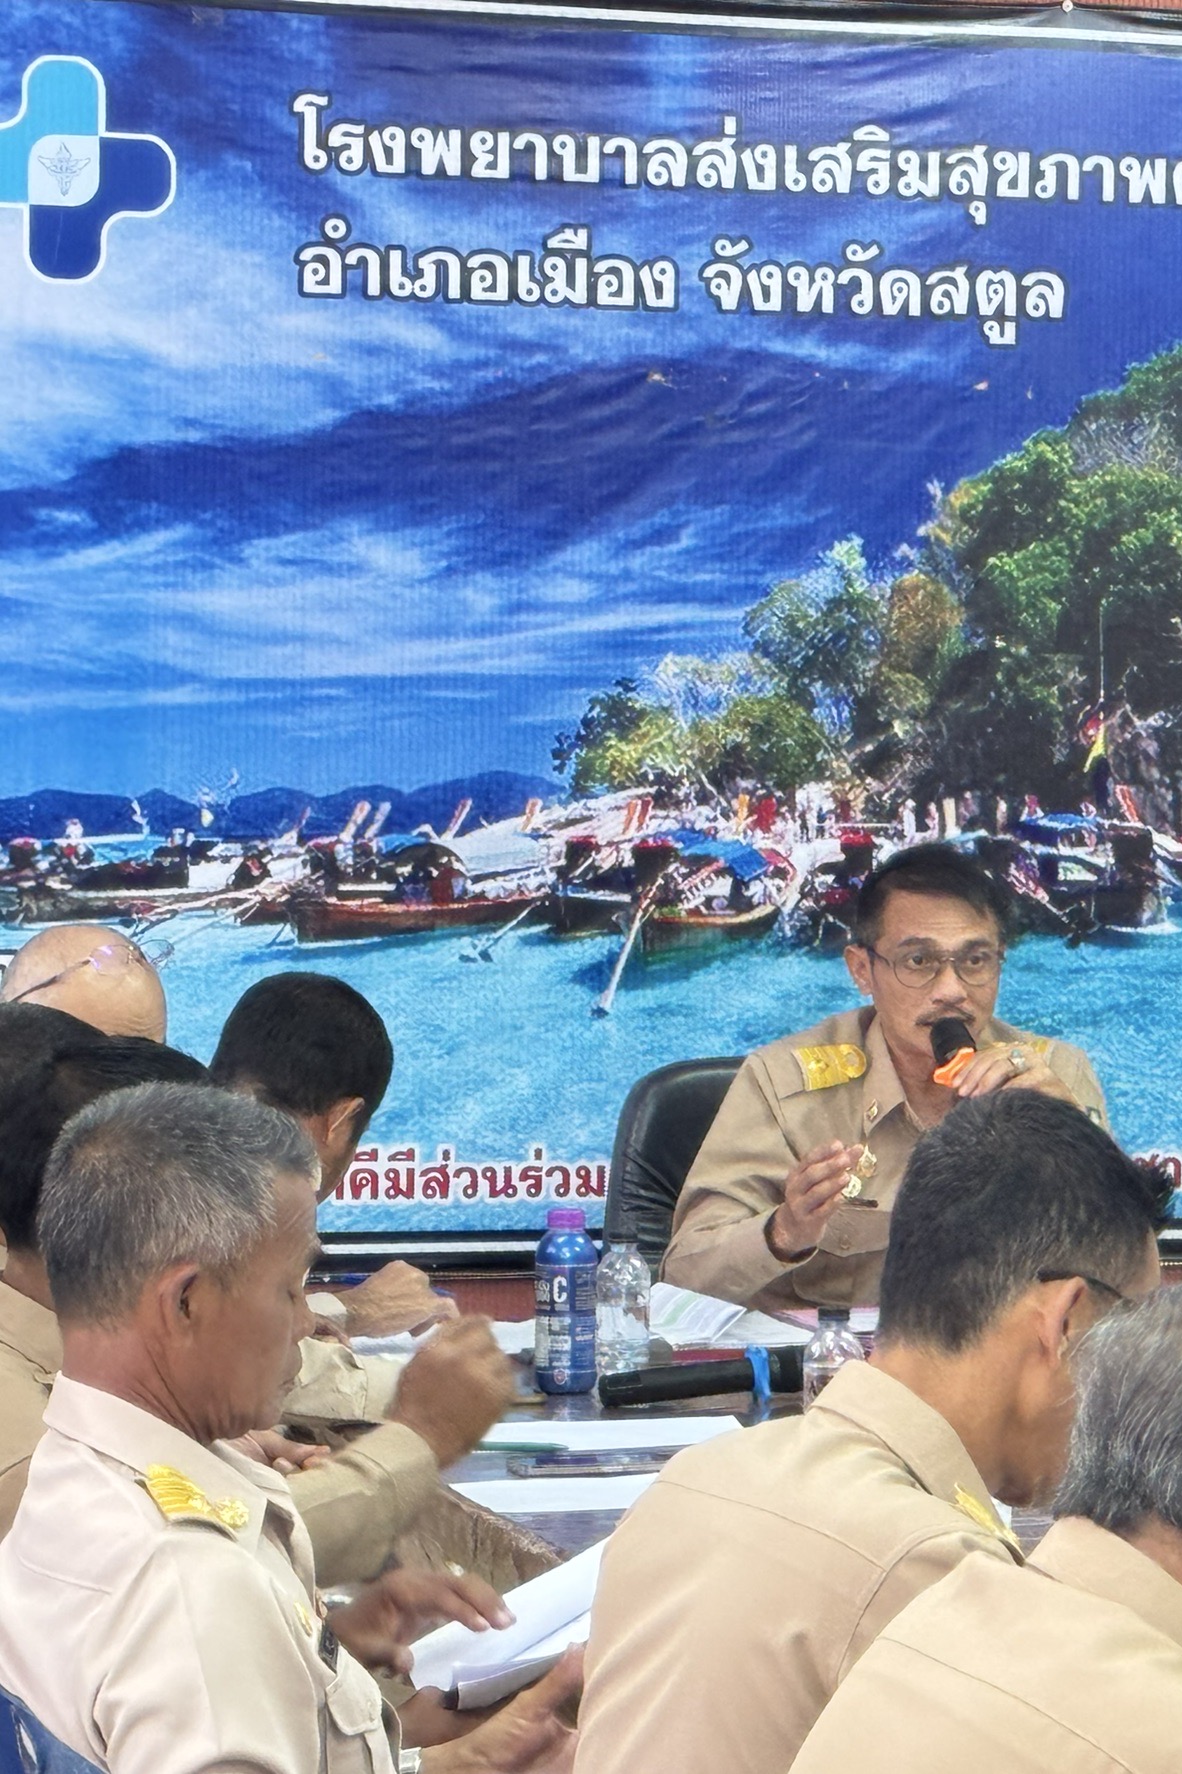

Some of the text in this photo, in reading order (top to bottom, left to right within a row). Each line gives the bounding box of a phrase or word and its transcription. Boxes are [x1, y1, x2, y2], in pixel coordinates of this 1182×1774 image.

[299, 219, 1067, 345] อำเภอเมือง จังหวัดสตูล
